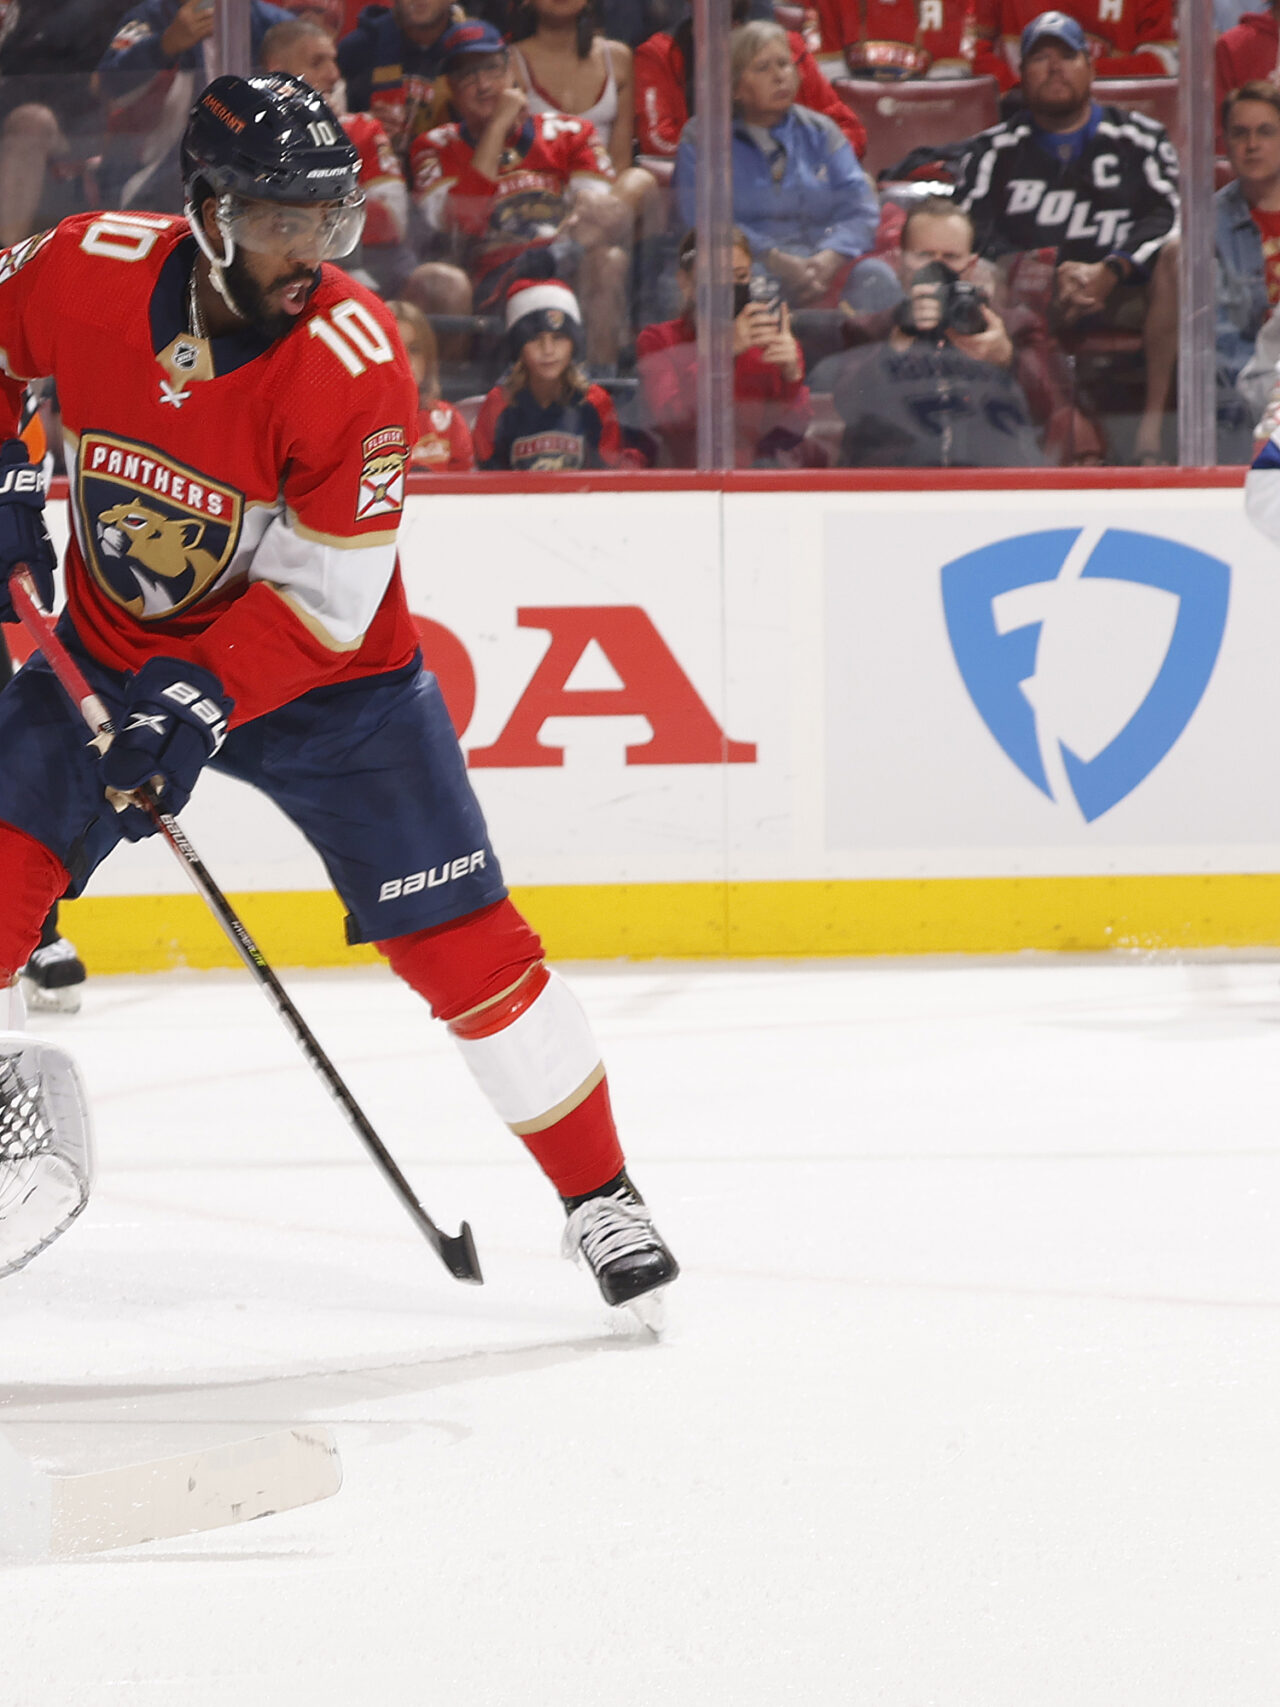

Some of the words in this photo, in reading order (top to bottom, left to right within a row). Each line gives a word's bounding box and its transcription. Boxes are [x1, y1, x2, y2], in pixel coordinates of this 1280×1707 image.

[202, 93, 248, 134] AMERANT
[306, 121, 338, 147] 10
[1092, 153, 1121, 188] C
[78, 211, 174, 263] 10
[306, 297, 395, 378] 10
[91, 445, 223, 517] PANTHERS
[159, 813, 199, 864] BAUER
[377, 848, 488, 903] BAUER
